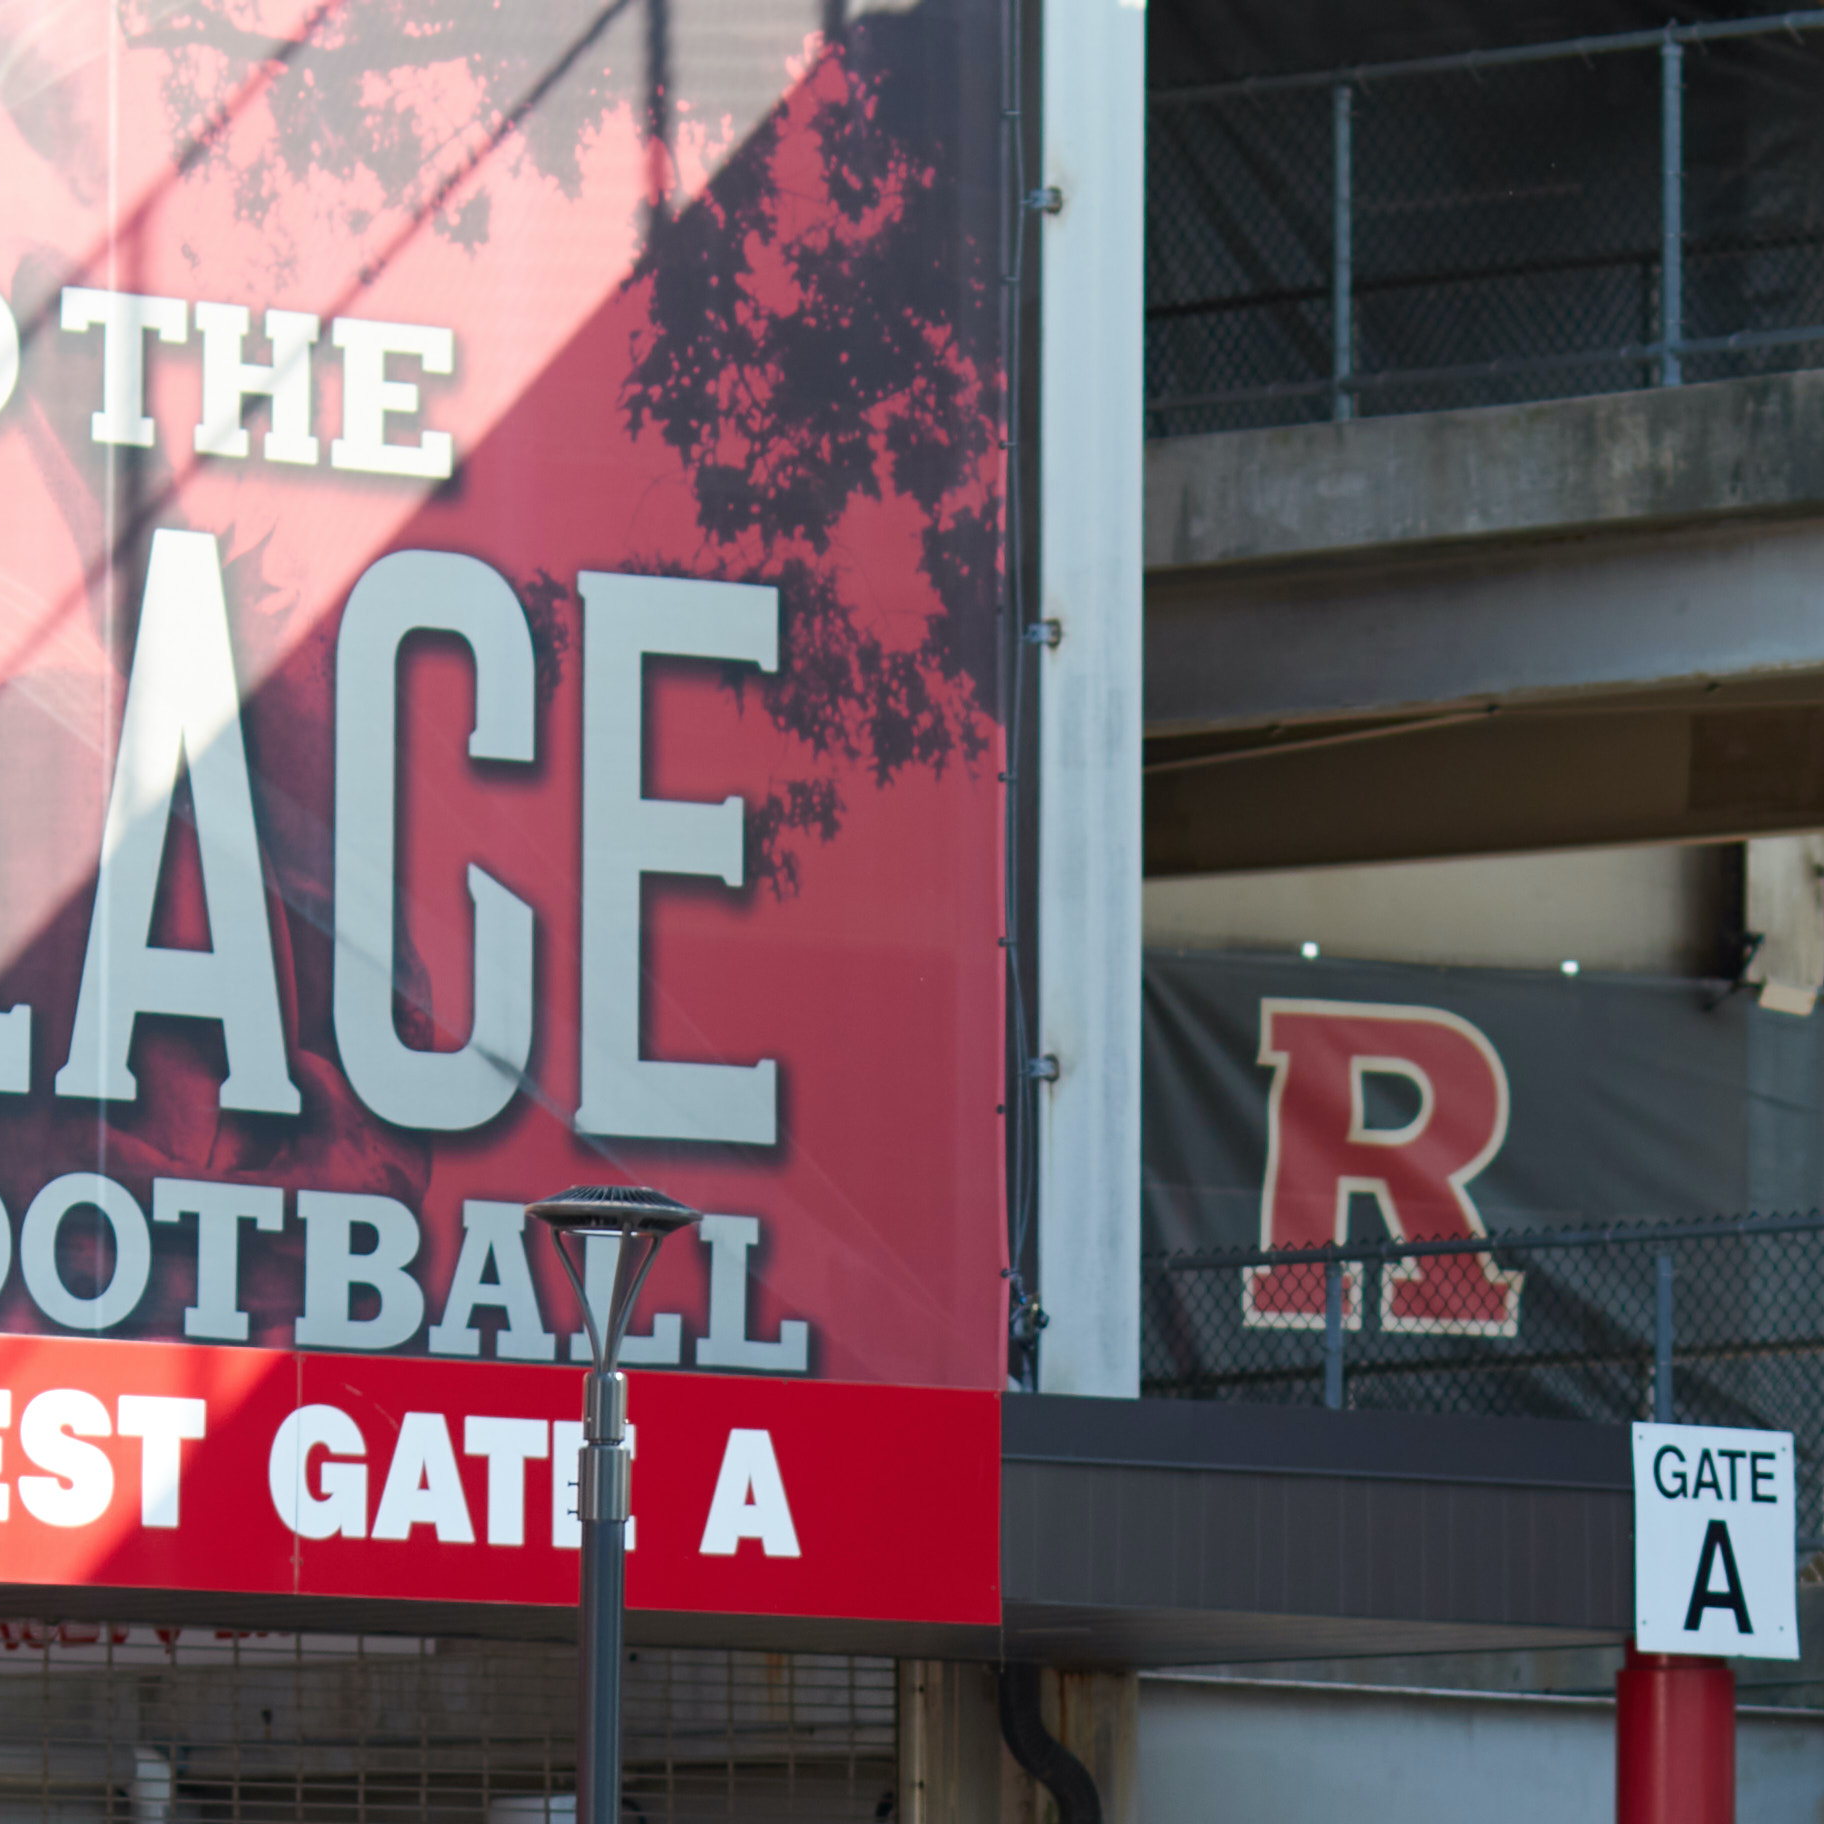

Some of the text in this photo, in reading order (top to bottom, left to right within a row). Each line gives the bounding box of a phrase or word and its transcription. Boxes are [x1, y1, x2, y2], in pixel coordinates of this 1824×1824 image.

[60, 284, 455, 479] THE
[1241, 996, 1526, 1337] R
[699, 1428, 802, 1558] A
[1652, 1443, 1779, 1503] GATE
[1682, 1518, 1755, 1635] A
